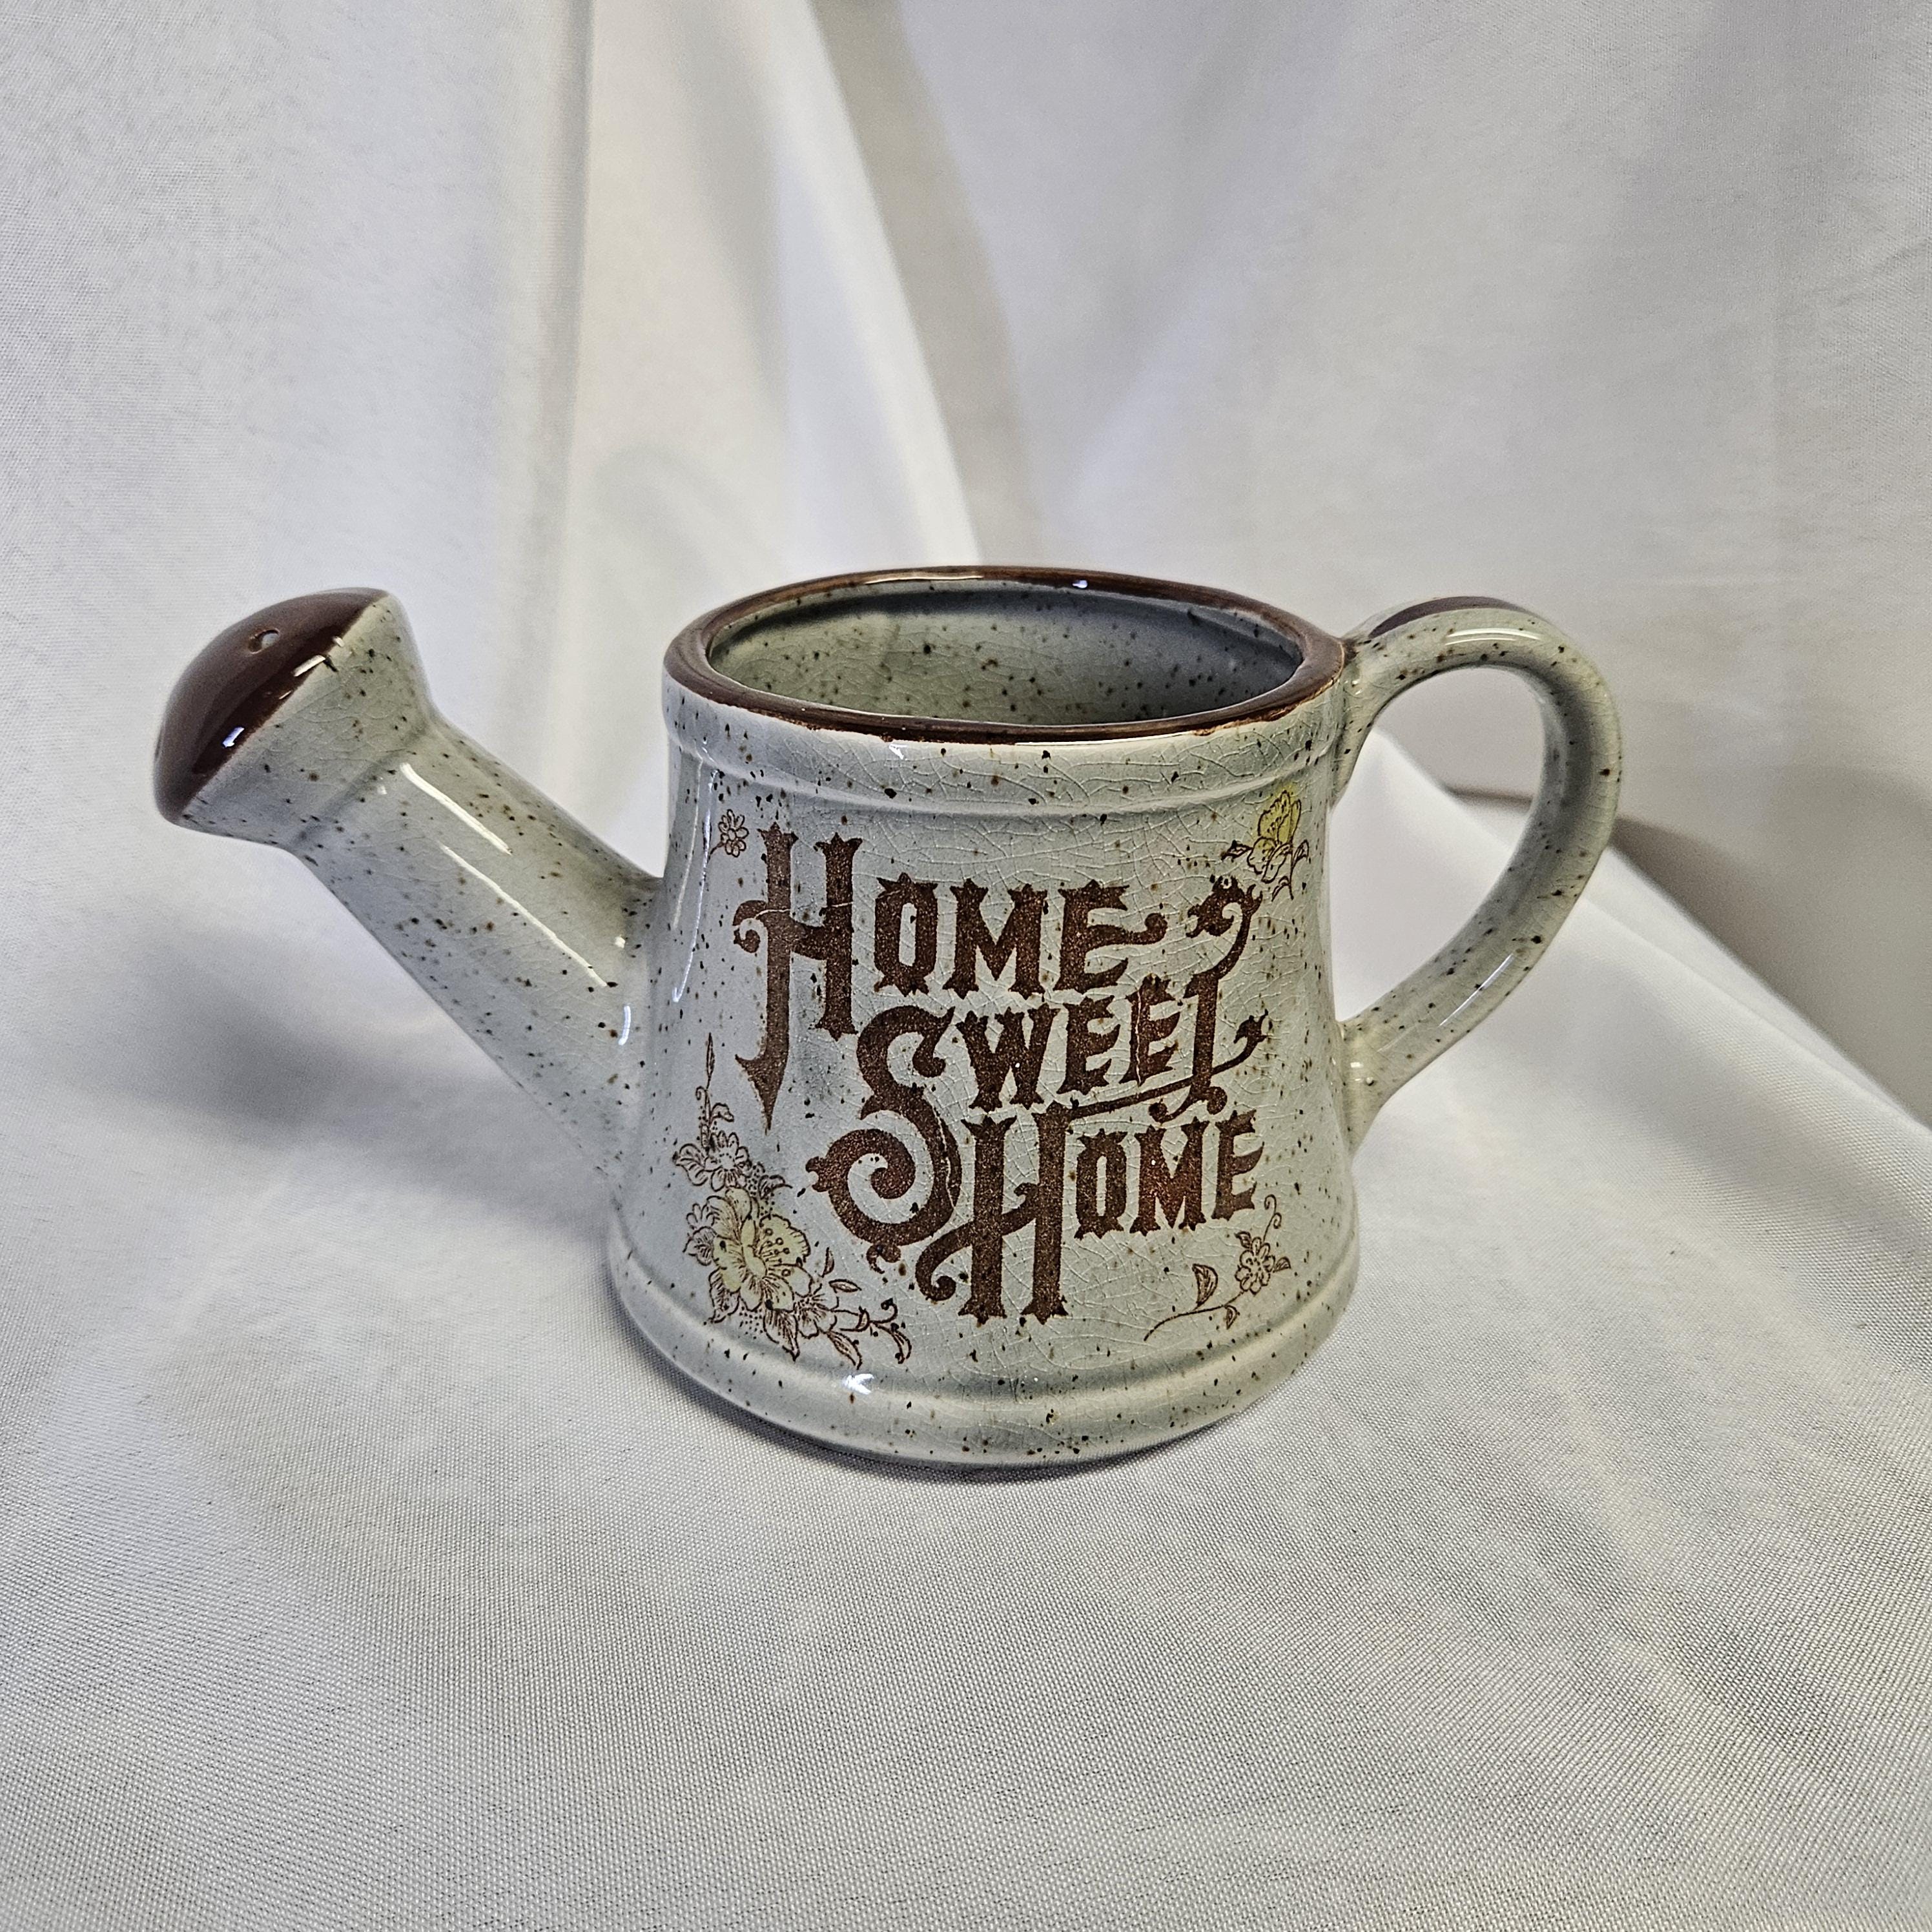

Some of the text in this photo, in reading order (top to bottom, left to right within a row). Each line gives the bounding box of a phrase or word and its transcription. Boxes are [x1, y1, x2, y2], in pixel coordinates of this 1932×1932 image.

[732, 822, 1167, 1132] HOME
[805, 876, 1269, 1273] SWEET
[915, 1100, 1264, 1324] HOME
